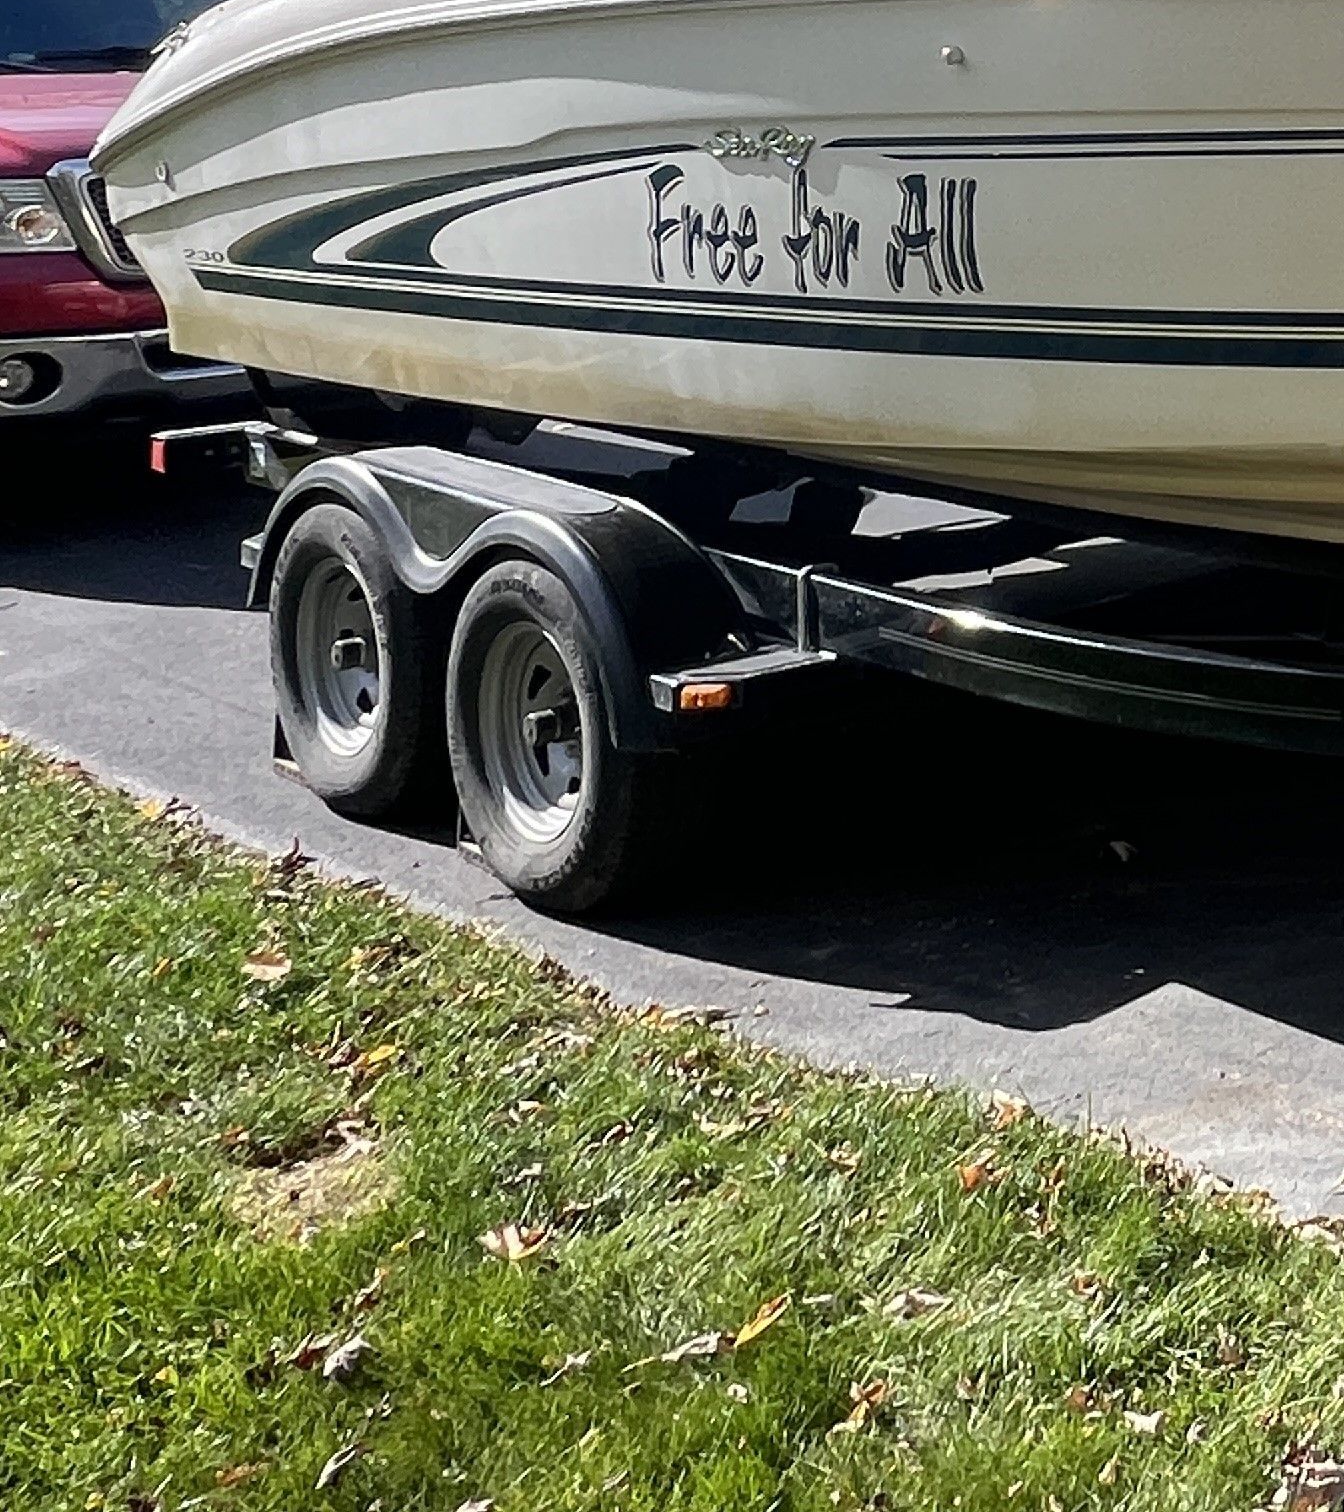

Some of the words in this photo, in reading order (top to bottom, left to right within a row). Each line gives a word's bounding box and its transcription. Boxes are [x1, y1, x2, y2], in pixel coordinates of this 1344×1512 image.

[646, 164, 763, 285] Free
[782, 169, 860, 294] for
[887, 173, 985, 295] All
